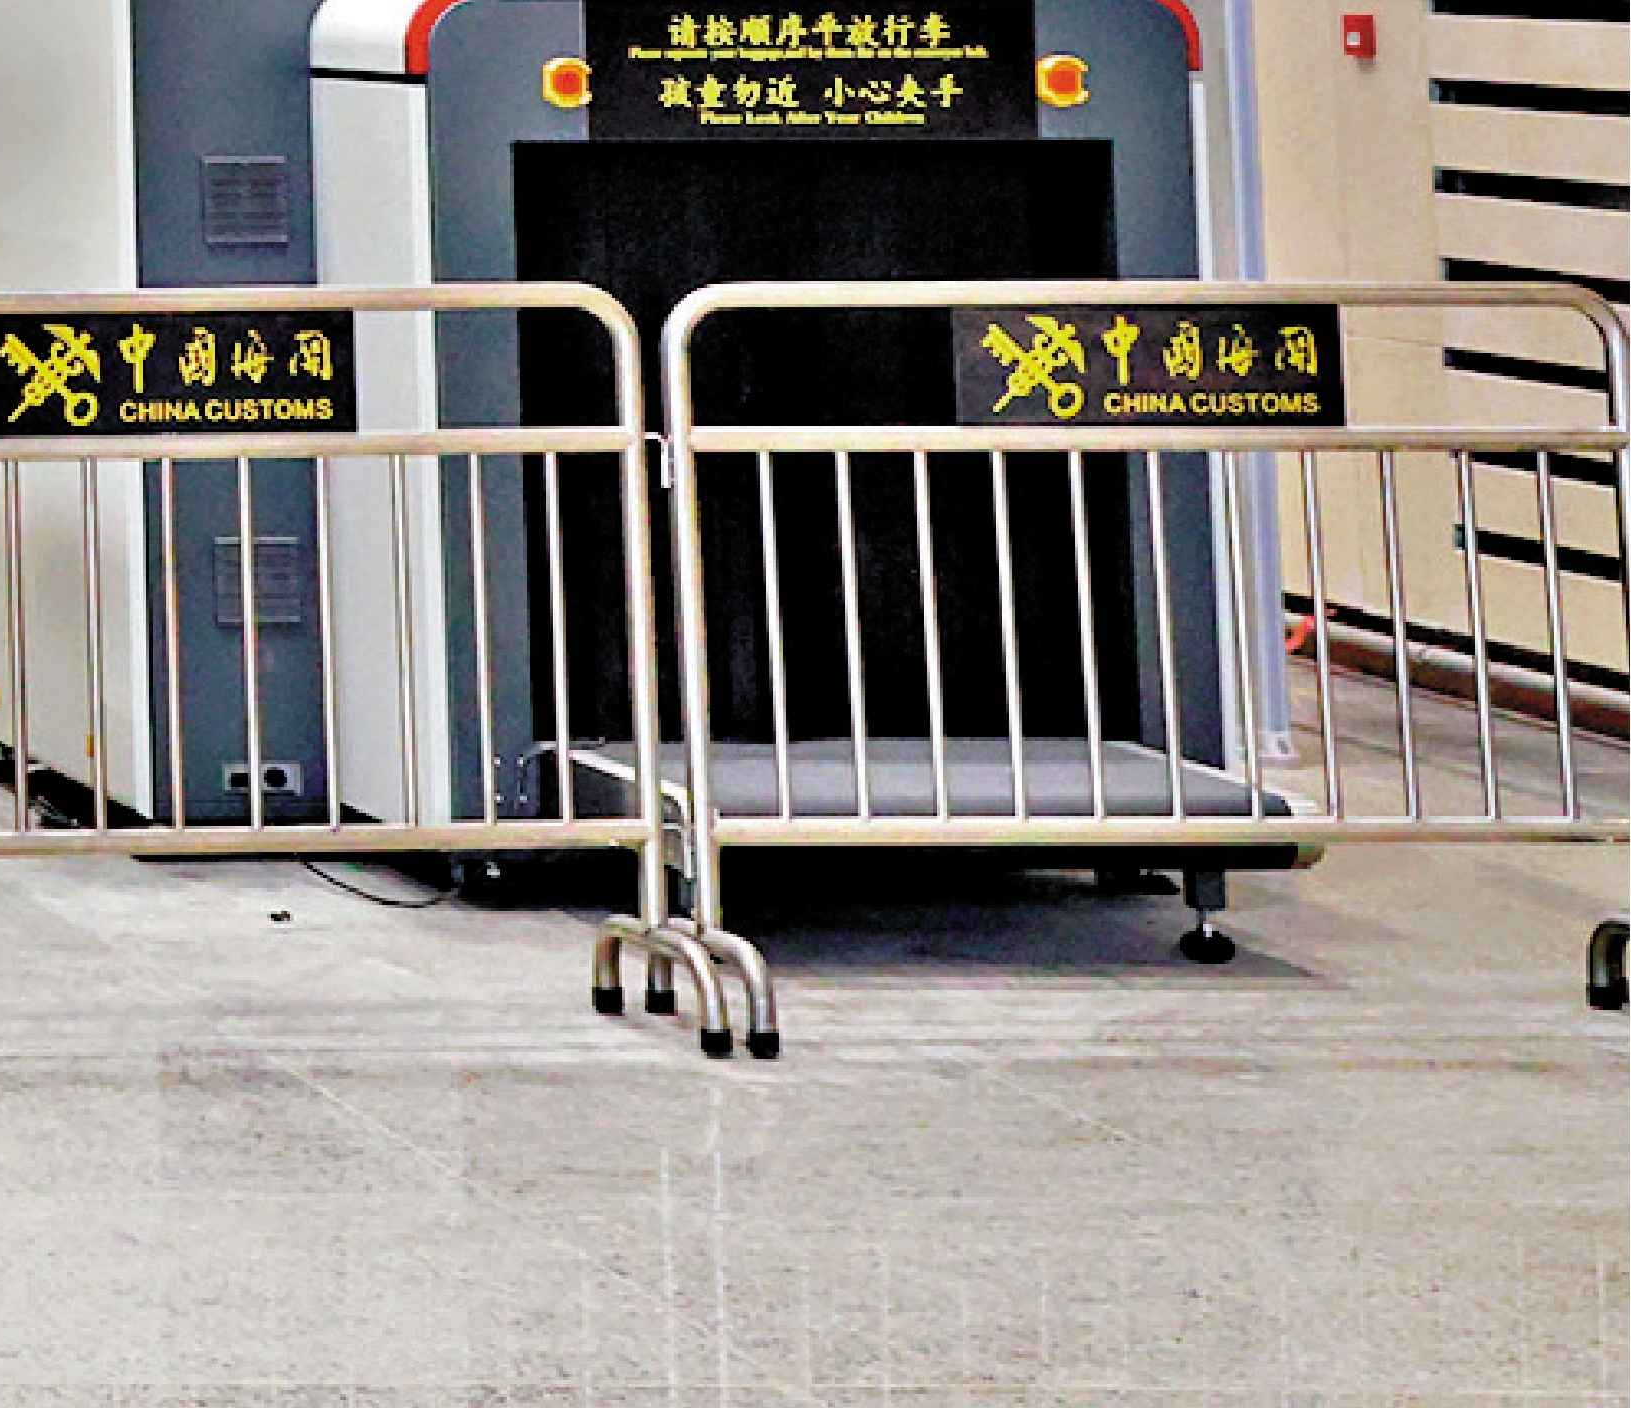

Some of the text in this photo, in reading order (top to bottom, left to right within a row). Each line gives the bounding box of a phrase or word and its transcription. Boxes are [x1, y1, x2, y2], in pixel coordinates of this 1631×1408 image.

[825, 74, 963, 107] 小心夹手
[120, 397, 333, 422] CHINA CUSTOMS
[1104, 393, 1321, 415] CHINA CUSTOMS
